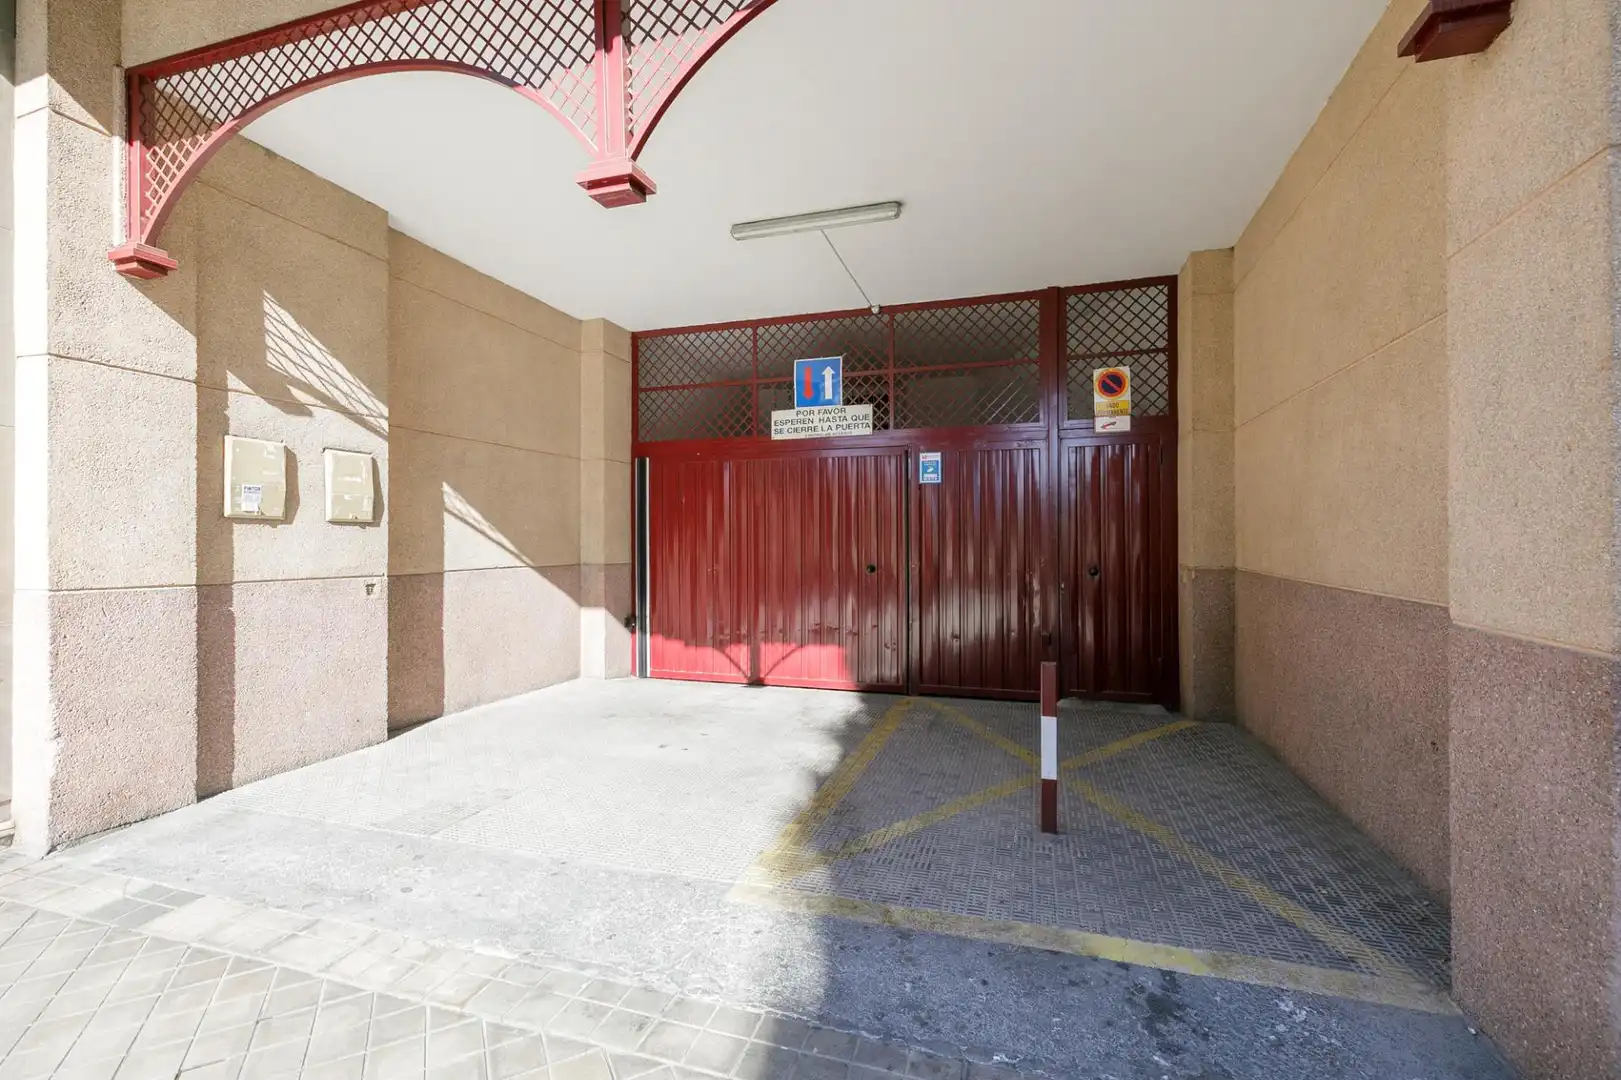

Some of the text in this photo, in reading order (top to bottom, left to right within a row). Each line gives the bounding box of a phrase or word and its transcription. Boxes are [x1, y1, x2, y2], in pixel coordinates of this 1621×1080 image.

[818, 407, 846, 416] FAVOR
[774, 413, 870, 427] ESPEREN HASTA QUE
[774, 427, 785, 435] SE
[787, 425, 819, 434] CIERRE
[821, 424, 833, 432] LA
[835, 422, 871, 431] PUERTA
